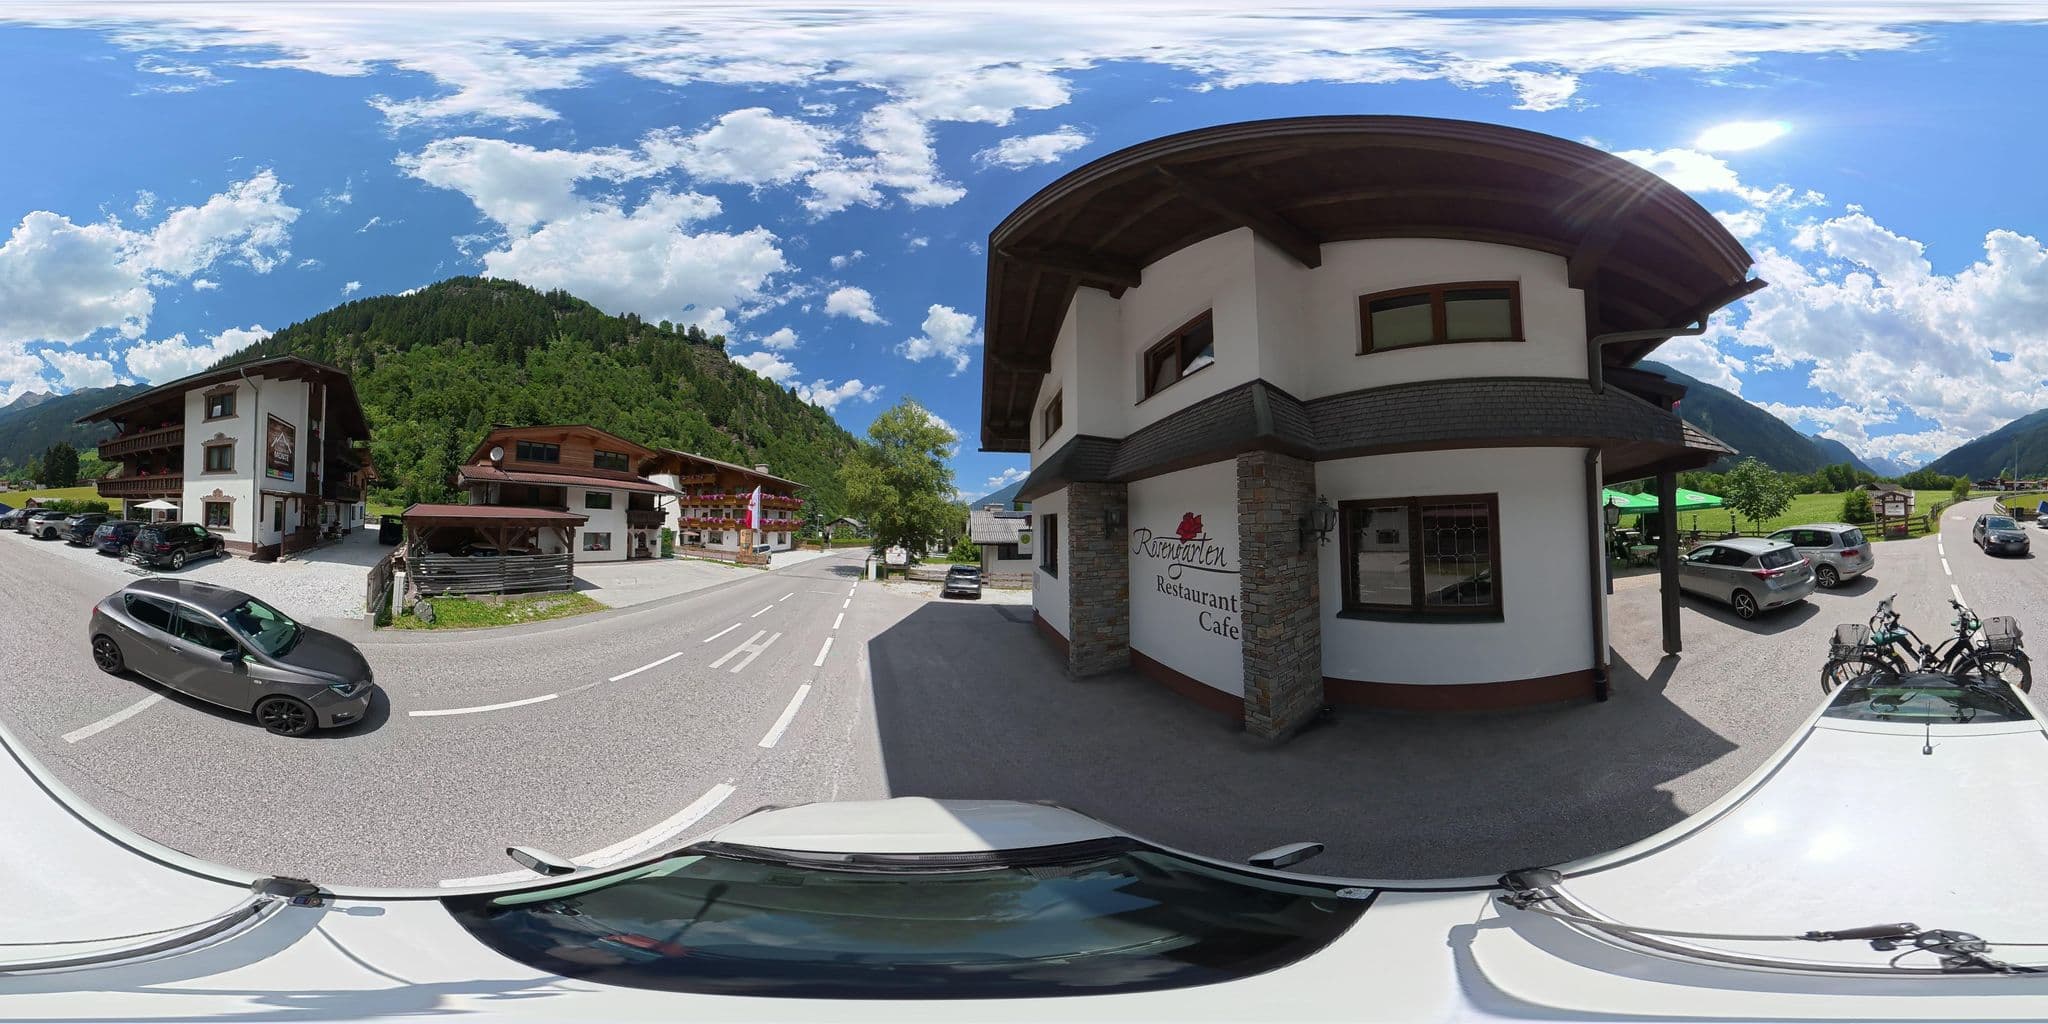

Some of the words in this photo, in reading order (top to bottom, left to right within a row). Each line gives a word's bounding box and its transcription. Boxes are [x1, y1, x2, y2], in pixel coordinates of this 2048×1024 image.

[1132, 527, 1230, 579] Rosengarten
[1157, 575, 1238, 613] Restaurant
[1199, 611, 1240, 640] Cafe
